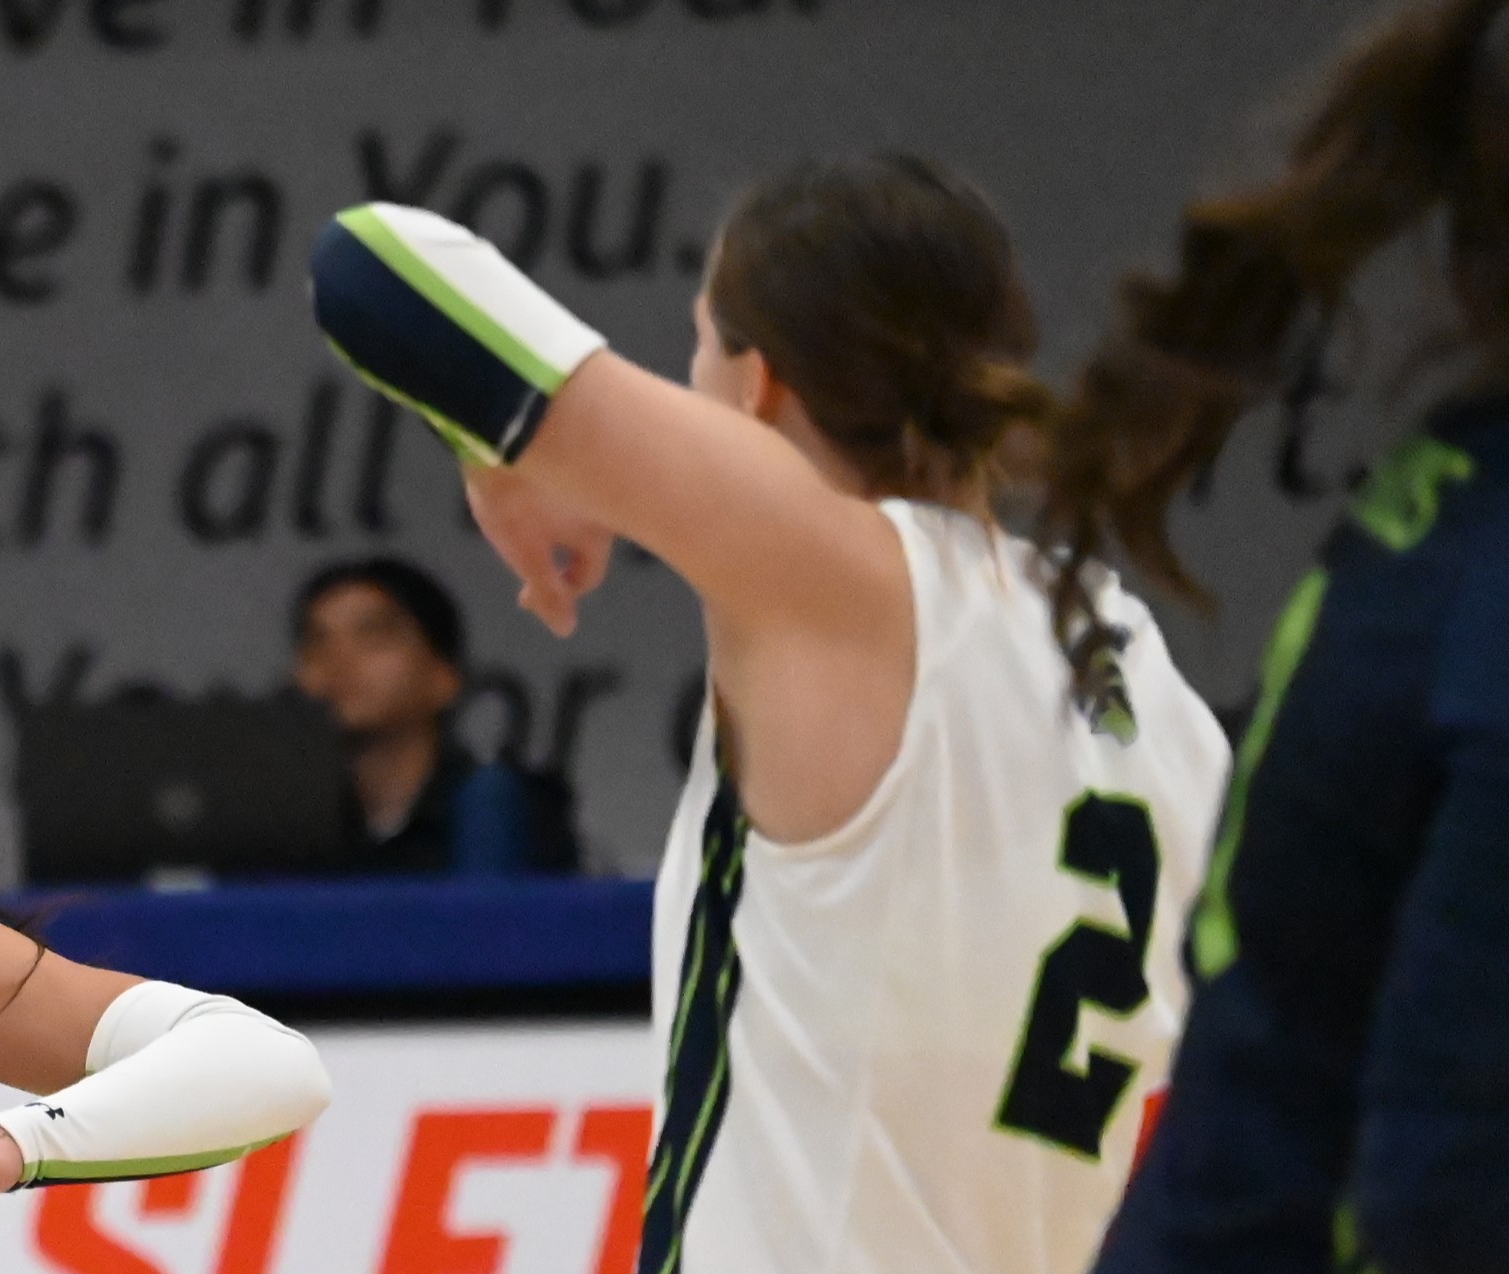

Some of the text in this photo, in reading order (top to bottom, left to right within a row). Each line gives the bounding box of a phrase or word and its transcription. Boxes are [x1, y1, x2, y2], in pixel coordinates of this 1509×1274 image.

[127, 132, 282, 294] in
[178, 376, 398, 546] all
[990, 786, 1162, 1165] 2
